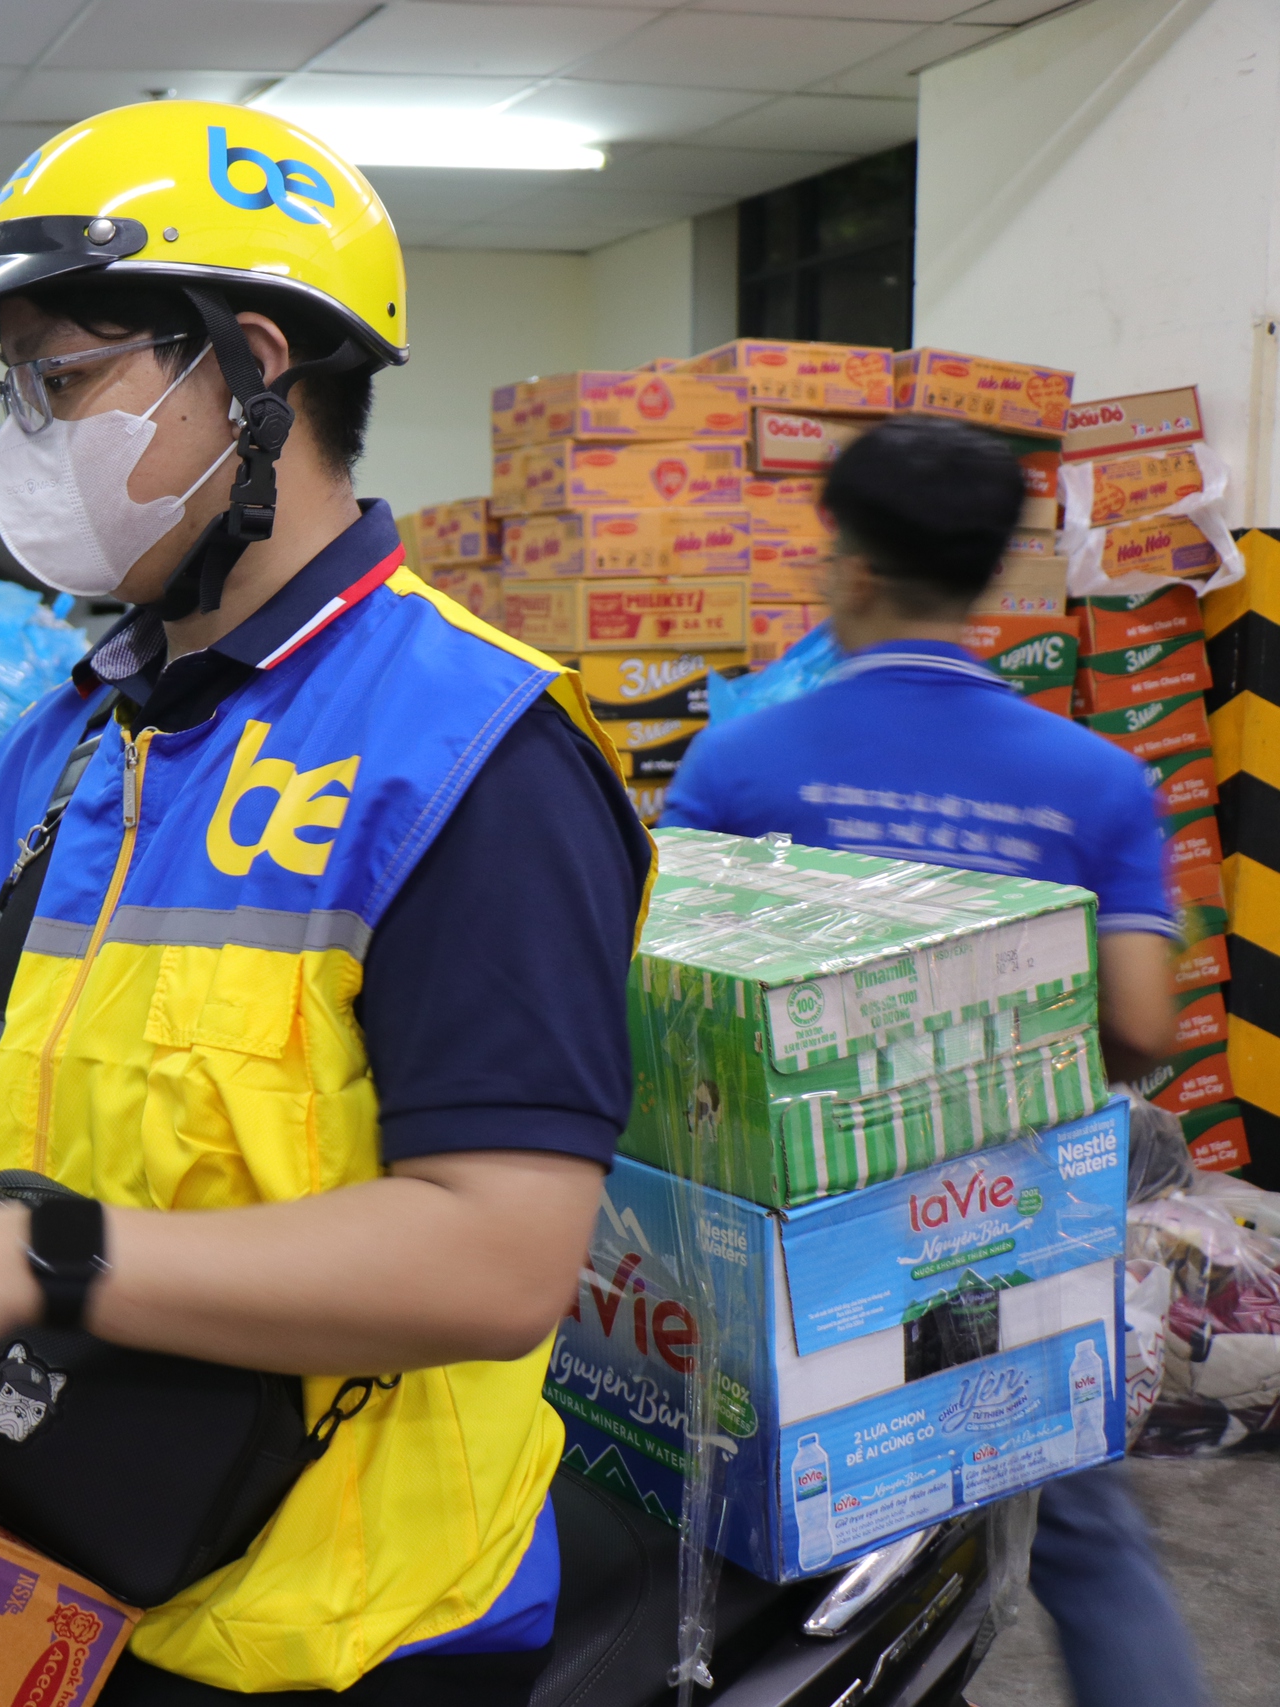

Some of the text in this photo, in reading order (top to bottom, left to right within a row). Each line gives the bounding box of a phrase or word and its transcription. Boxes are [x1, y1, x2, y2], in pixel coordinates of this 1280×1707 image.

[207, 126, 335, 225] be
[206, 719, 362, 876] be
[853, 956, 916, 990] Vinamilk
[1058, 1129, 1117, 1165] Nestlé
[1059, 1152, 1118, 1180] Waters
[909, 1169, 1015, 1232] laVie
[698, 1218, 748, 1251] Nestlé
[700, 1239, 748, 1267] Waters
[562, 1252, 702, 1374] Vie
[591, 1409, 642, 1448] MINERAL
[645, 1437, 686, 1470] WATER
[854, 1409, 926, 1445] 2 LỰA CHỌN
[846, 1444, 863, 1467] ĐỂ
[865, 1443, 879, 1460] AI
[881, 1432, 915, 1456] CŨNG
[5, 1573, 36, 1615] NSX:
[67, 1647, 89, 1689] Cook
